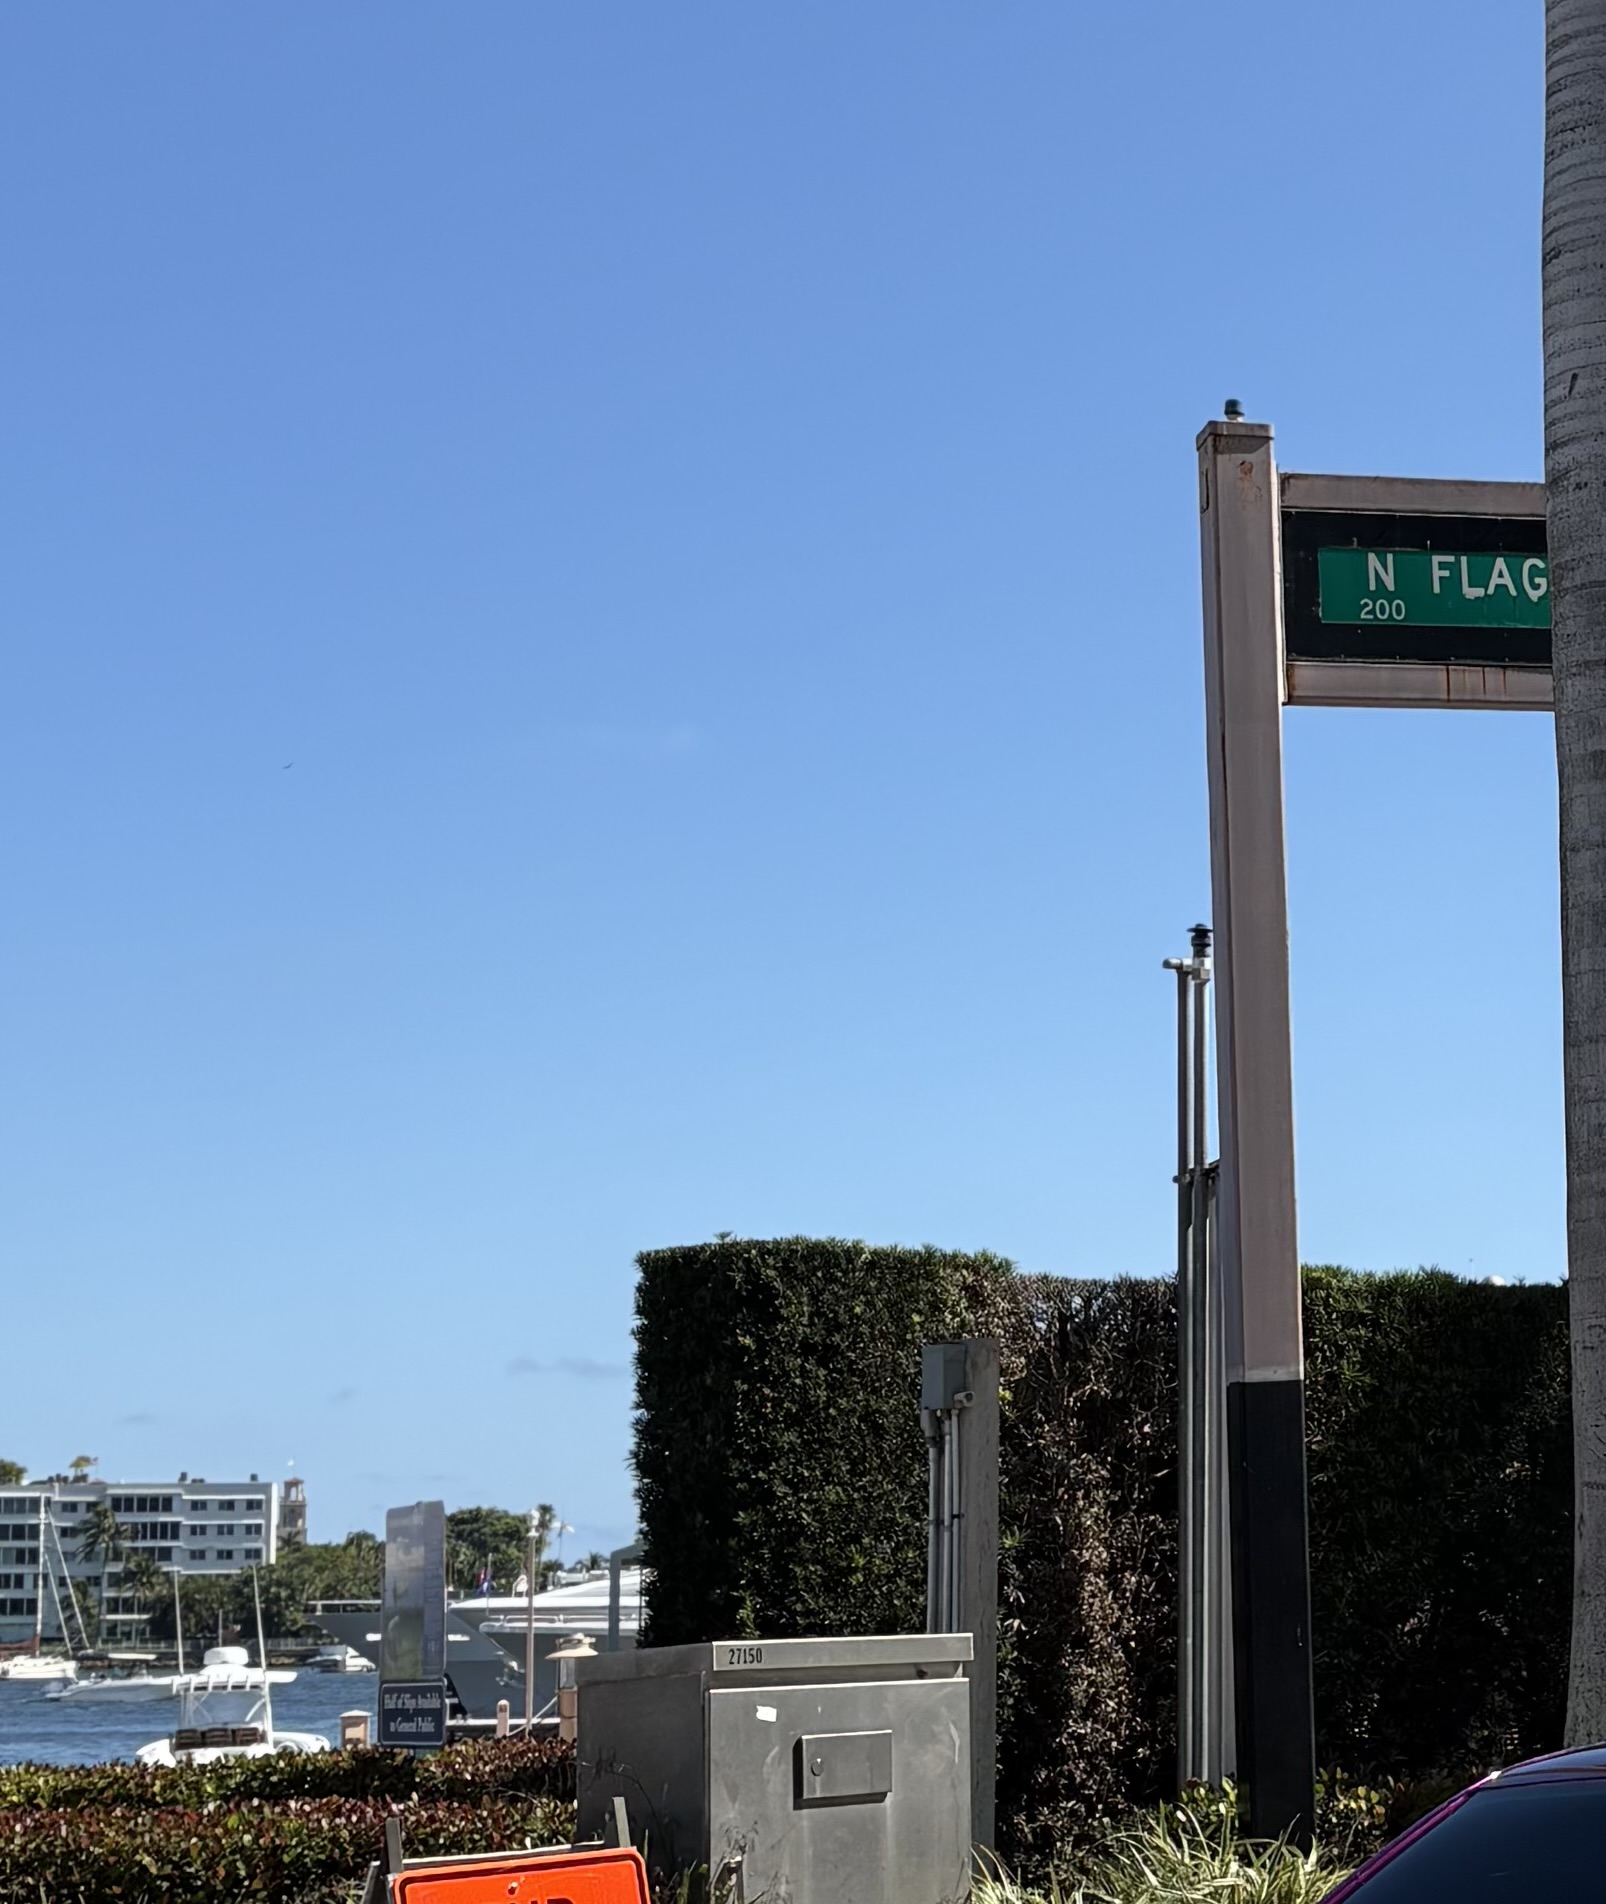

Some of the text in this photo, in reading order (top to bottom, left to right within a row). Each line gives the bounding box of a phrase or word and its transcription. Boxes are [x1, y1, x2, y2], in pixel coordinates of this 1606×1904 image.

[1367, 552, 1395, 591] N
[1359, 598, 1406, 620] 200
[728, 1647, 763, 1665] 27150
